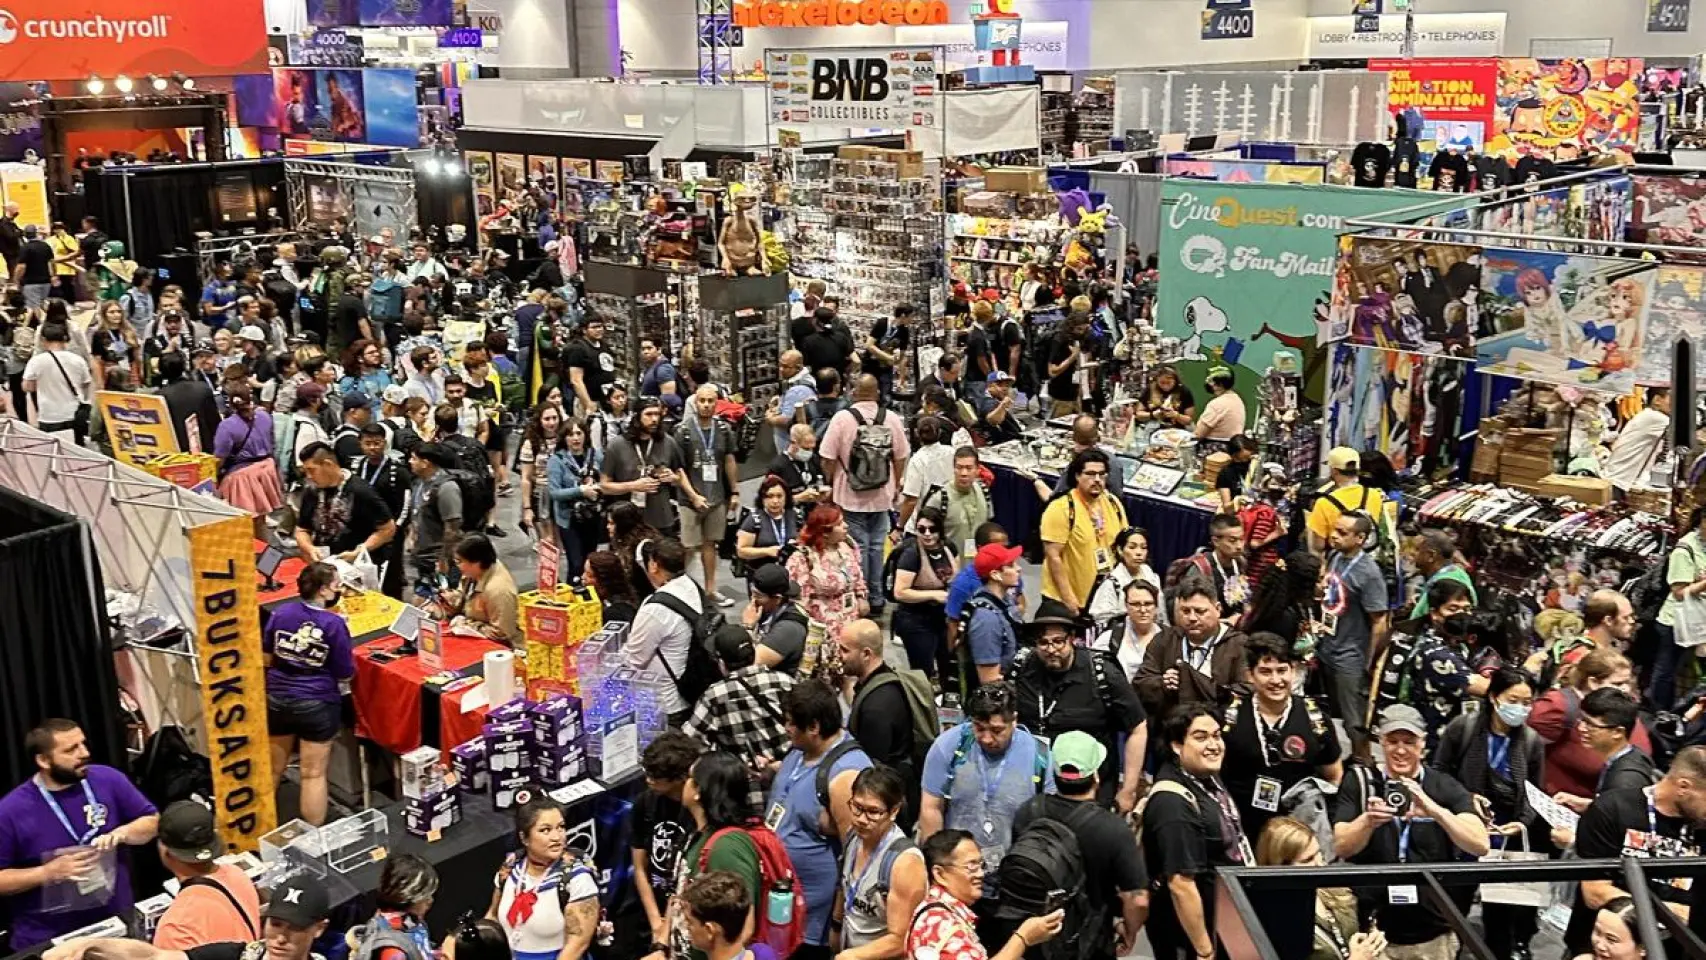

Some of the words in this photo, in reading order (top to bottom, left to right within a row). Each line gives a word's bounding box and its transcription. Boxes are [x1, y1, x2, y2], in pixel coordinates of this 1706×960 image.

[24, 15, 168, 43] crunchyroll
[1217, 15, 1250, 35] 4400
[452, 32, 479, 45] 4100
[1319, 33, 1350, 43] LOBBY
[1358, 32, 1420, 42] RESTROOS
[1428, 31, 1497, 41] TELEPHONES
[812, 58, 889, 101] BNB
[1388, 93, 1486, 107] OMINATION
[810, 105, 889, 120] COLLECTIBLES
